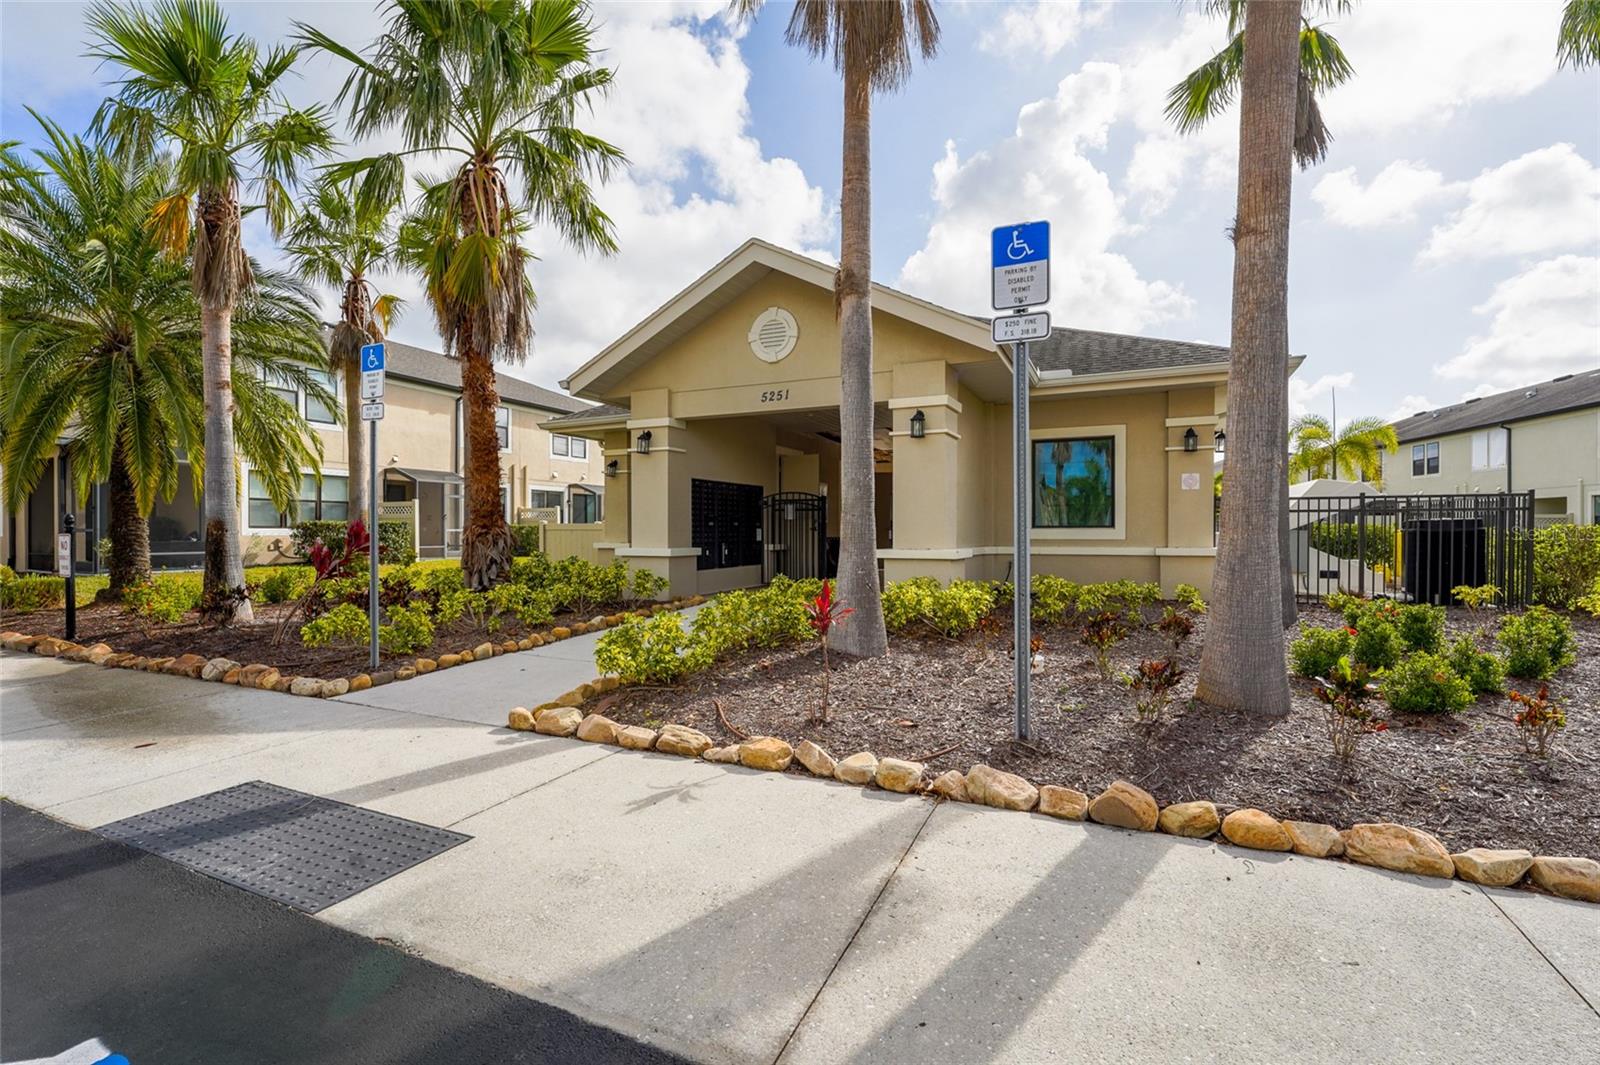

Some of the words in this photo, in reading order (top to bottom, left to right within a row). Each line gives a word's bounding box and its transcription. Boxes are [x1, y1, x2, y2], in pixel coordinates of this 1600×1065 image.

[1004, 266, 1028, 275] PARKING
[1007, 275, 1034, 285] DISABLED
[1010, 285, 1031, 294] PERMIT
[760, 389, 789, 403] 5251
